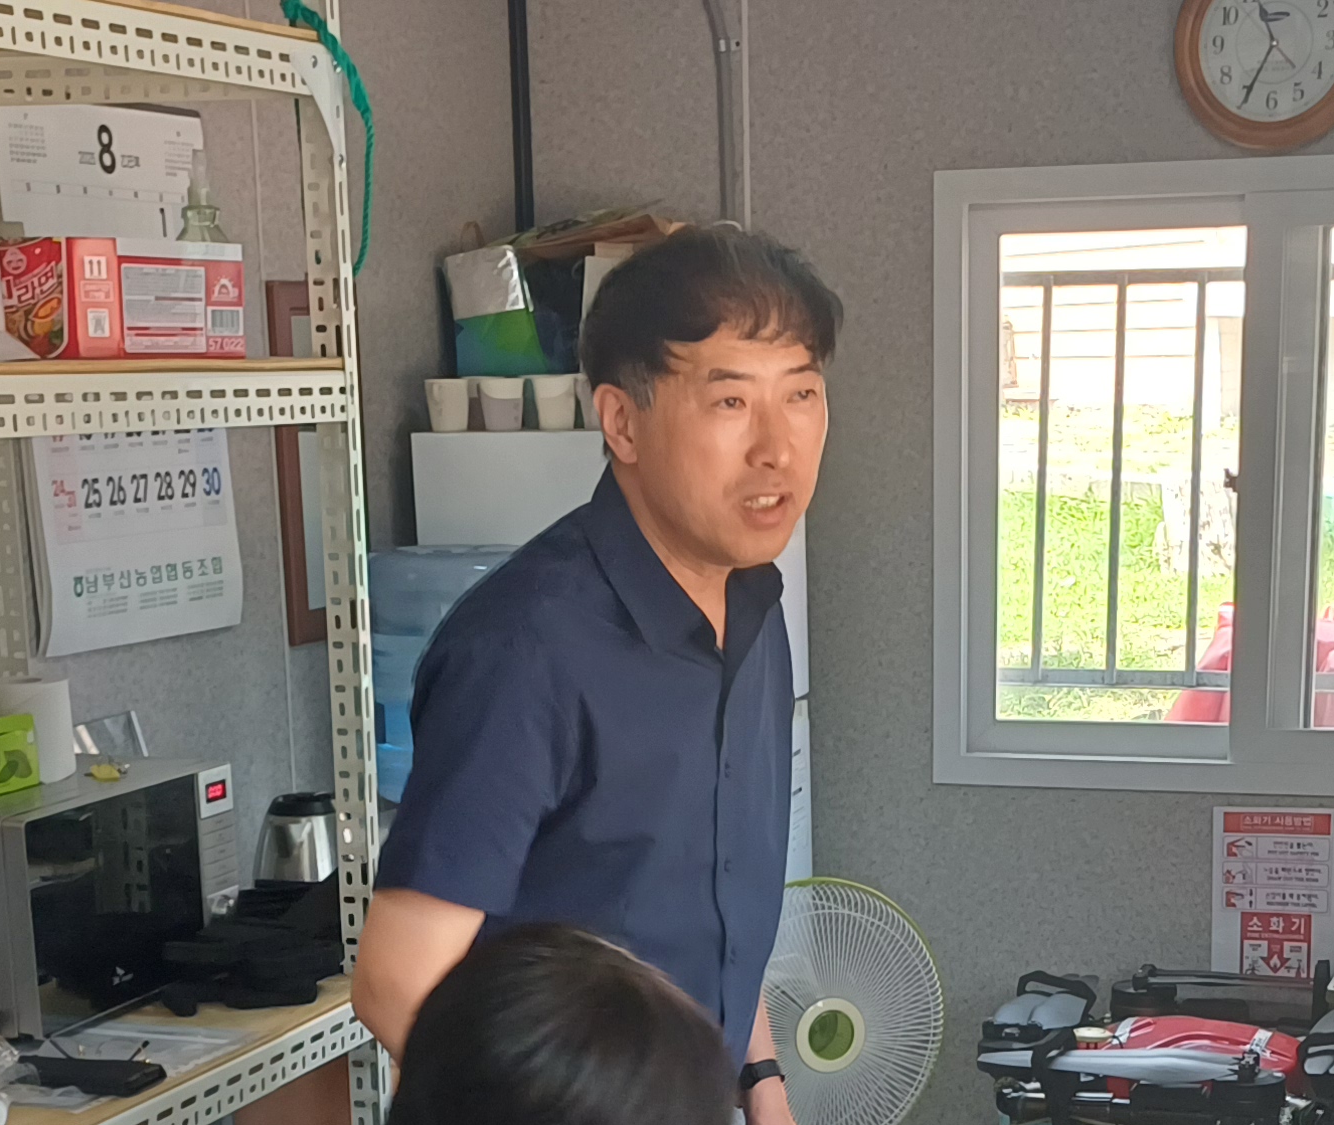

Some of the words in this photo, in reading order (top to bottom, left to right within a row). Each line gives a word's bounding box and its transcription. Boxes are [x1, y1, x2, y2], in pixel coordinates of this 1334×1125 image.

[1221, 6, 1240, 26] 10
[1212, 35, 1225, 55] 9
[1219, 65, 1232, 85] 8
[1312, 60, 1323, 80] 4
[1265, 90, 1278, 110] 6
[1292, 81, 1305, 102] 5
[97, 124, 116, 174] 8
[159, 207, 167, 238] 1
[81, 478, 102, 509] 25
[106, 475, 127, 506] 26
[130, 473, 148, 504] 27
[154, 470, 175, 501] 28
[178, 469, 197, 499] 29
[201, 467, 222, 497] 30
[1243, 815, 1271, 826] 소화기
[1274, 815, 1312, 827] 사용방법
